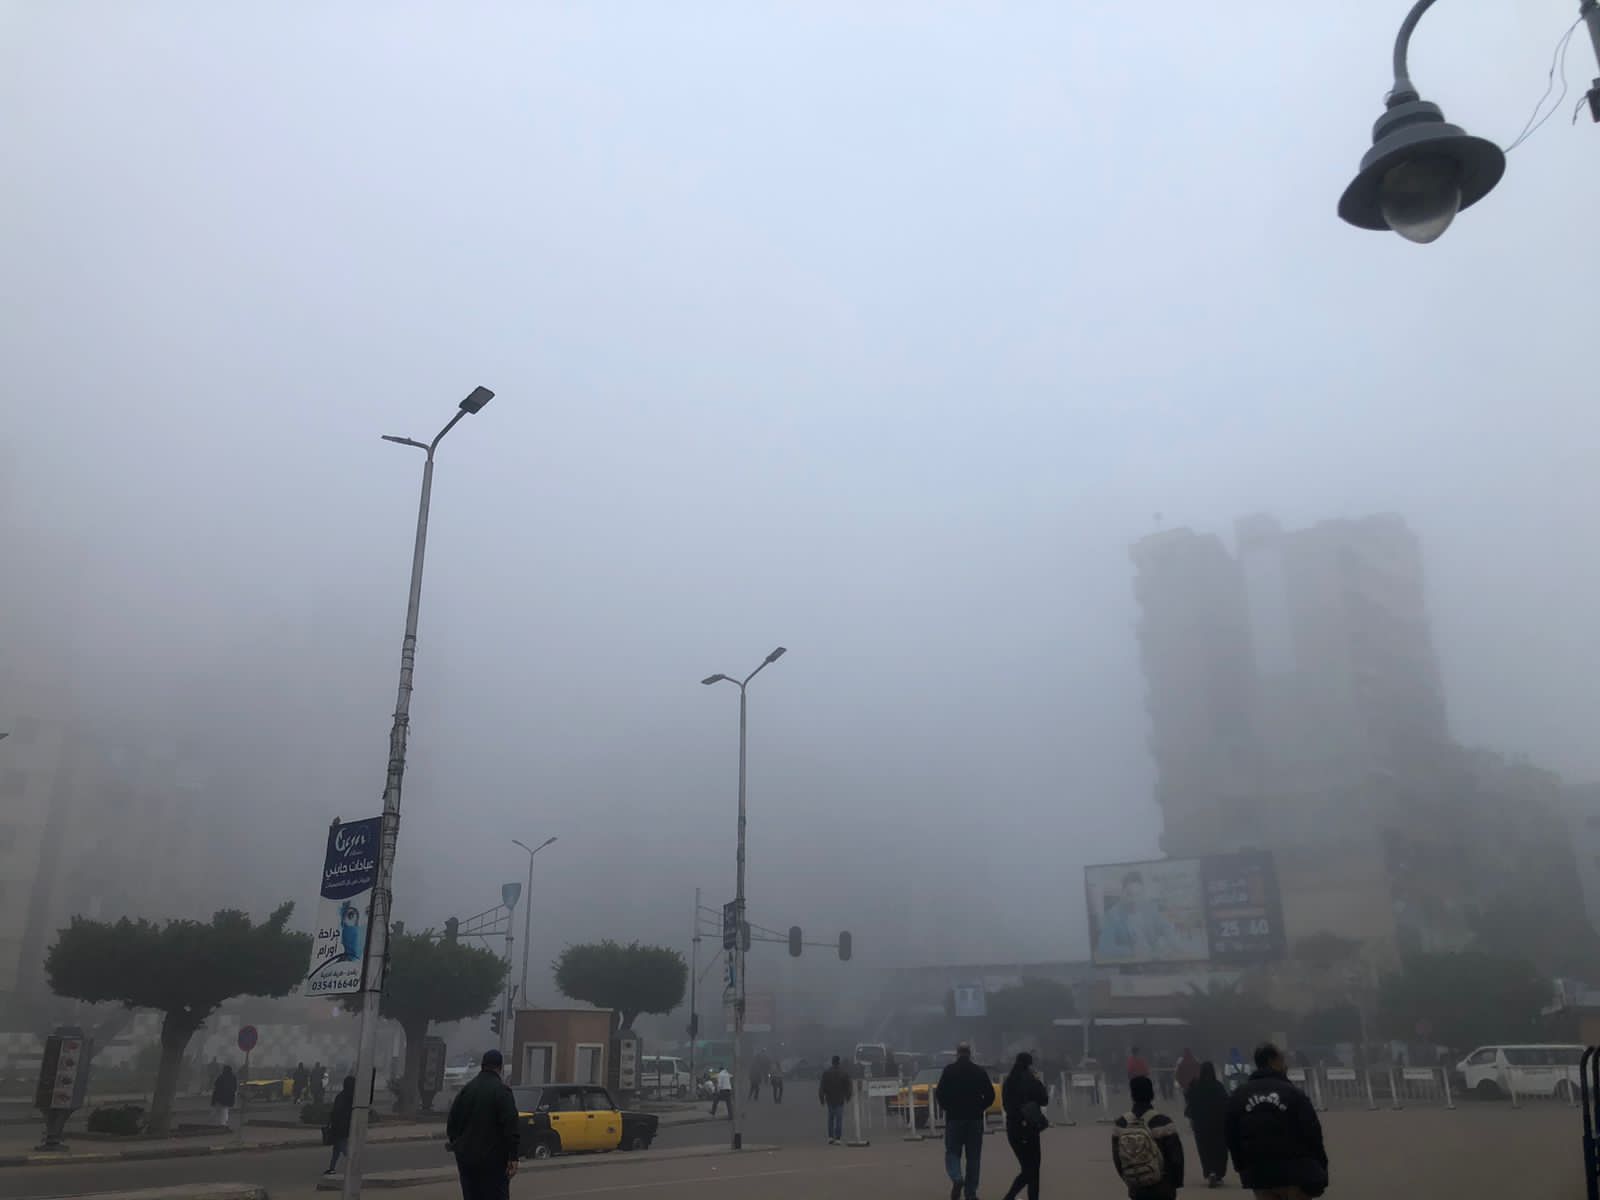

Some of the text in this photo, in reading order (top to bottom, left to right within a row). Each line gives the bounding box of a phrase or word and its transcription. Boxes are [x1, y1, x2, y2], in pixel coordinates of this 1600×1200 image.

[318, 927, 341, 941] جراحة
[316, 941, 338, 959] أورام
[311, 978, 359, 991] 035416640
